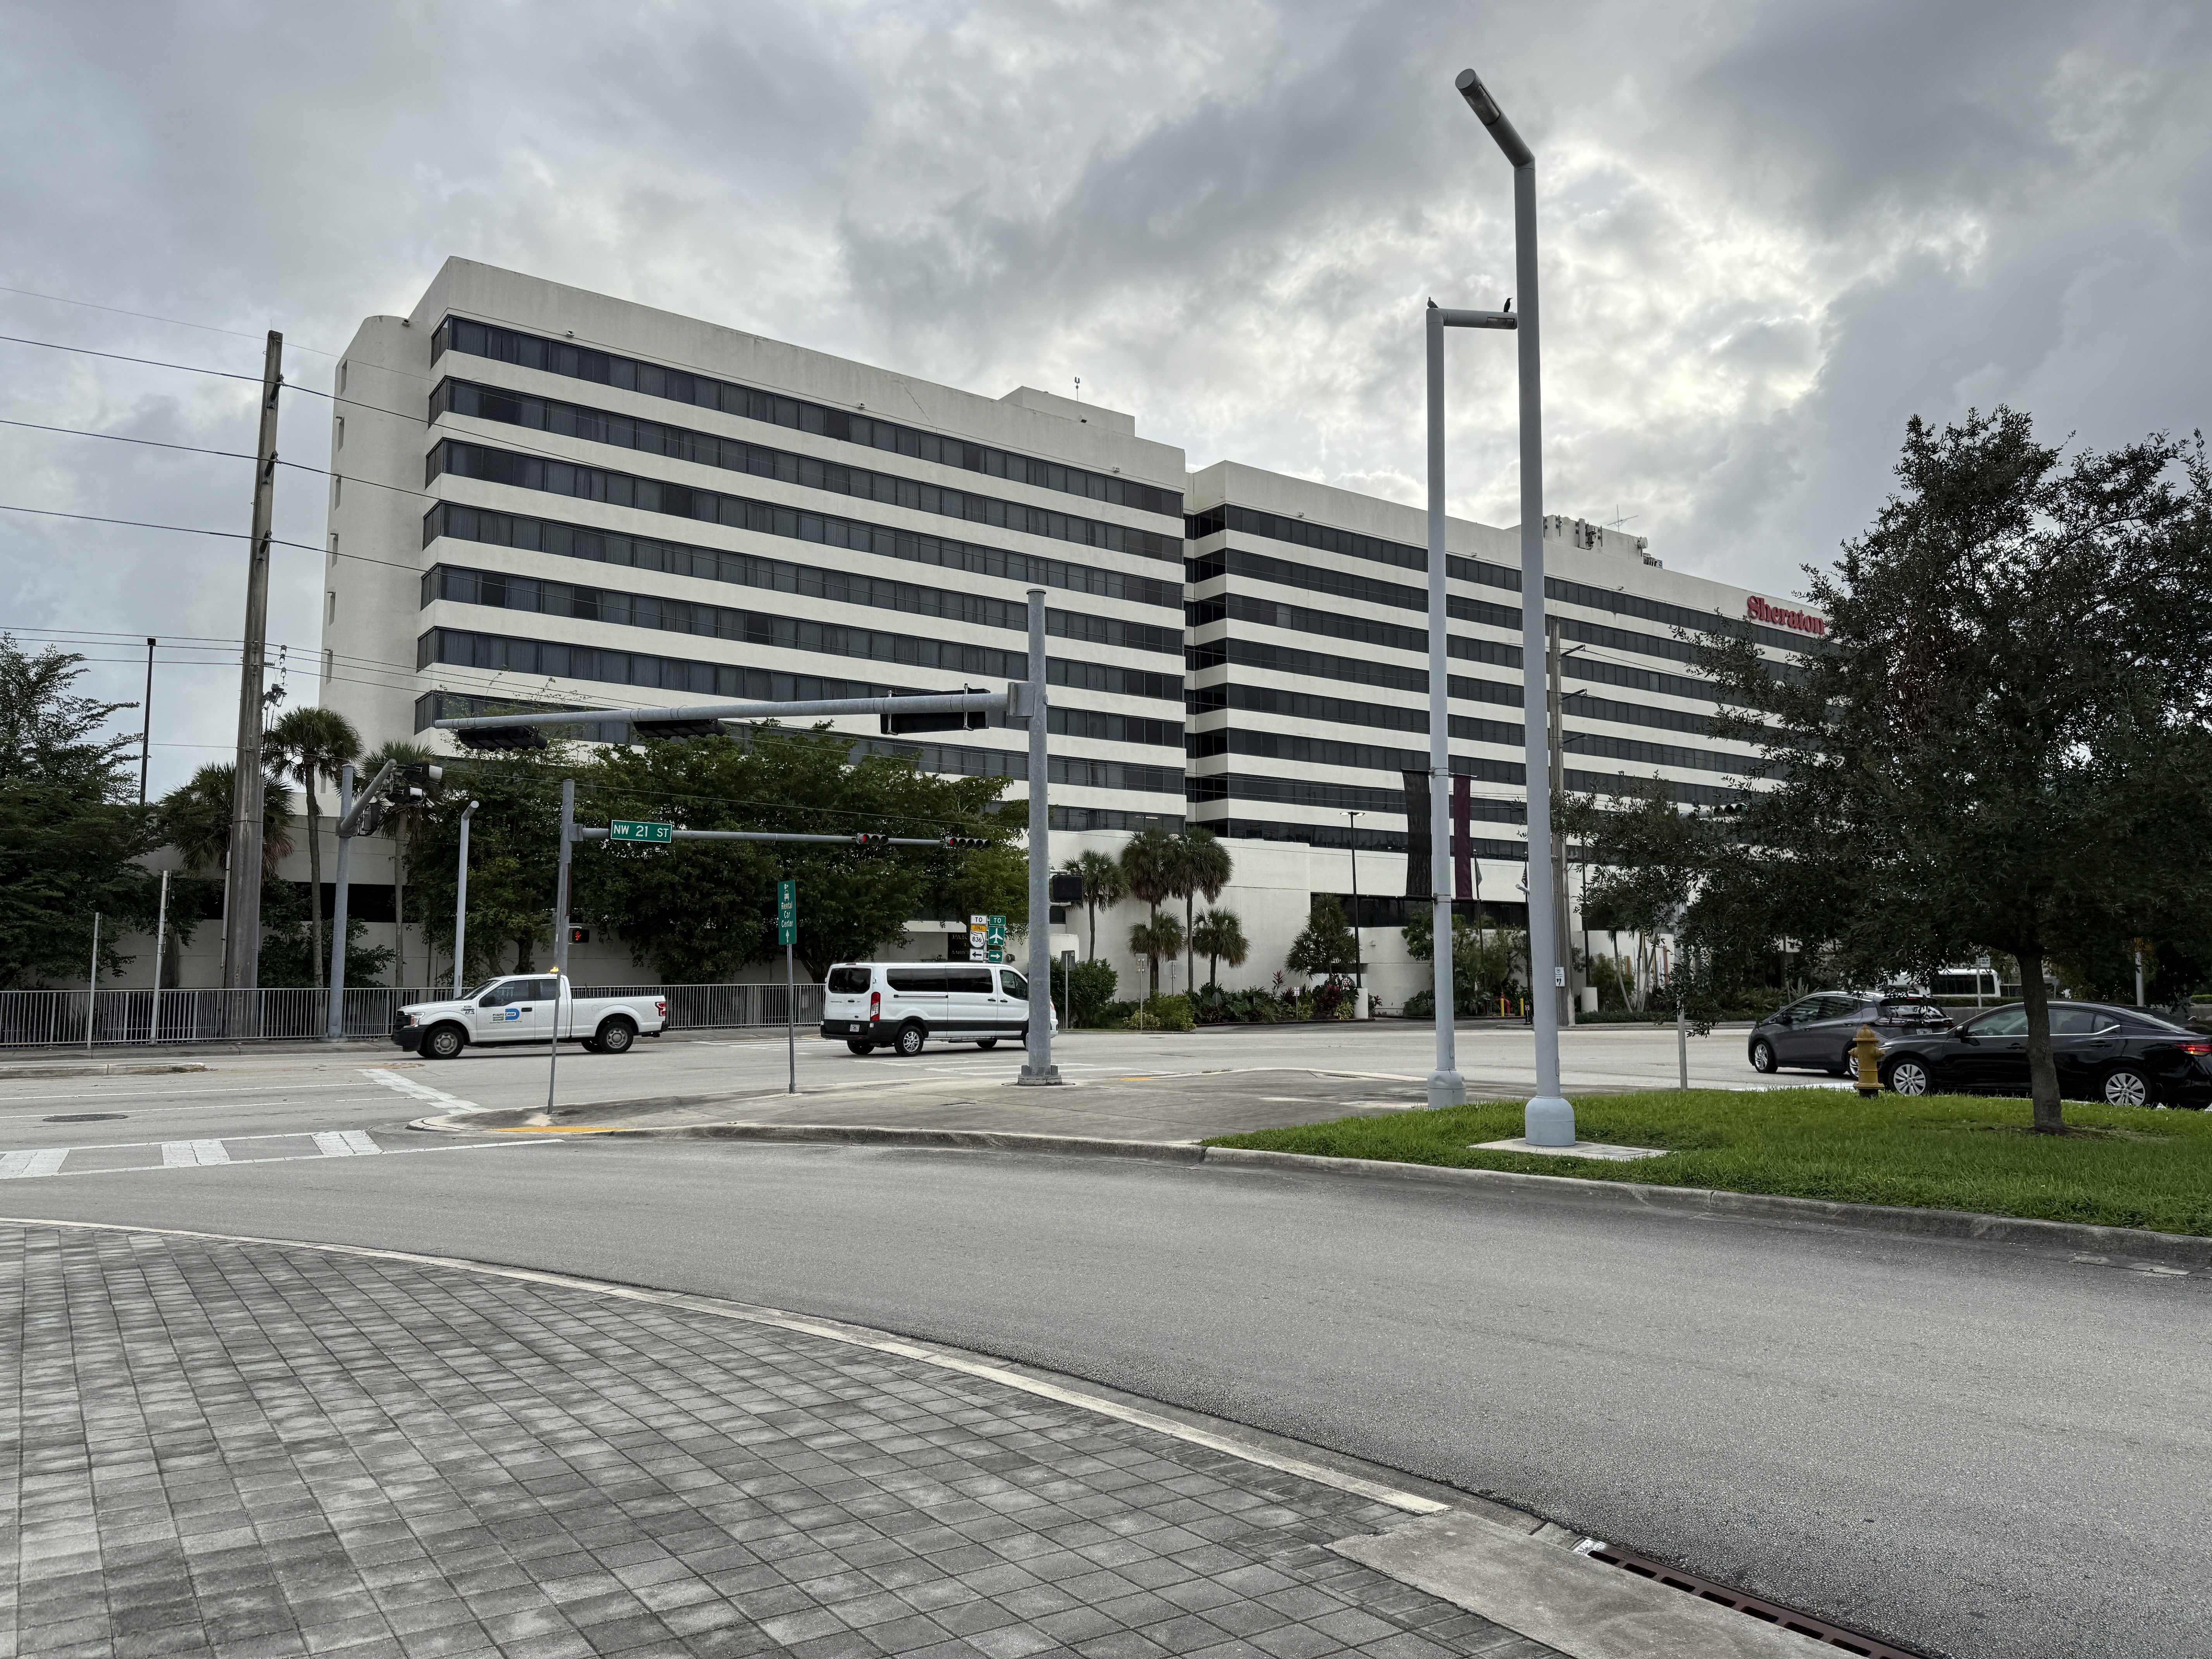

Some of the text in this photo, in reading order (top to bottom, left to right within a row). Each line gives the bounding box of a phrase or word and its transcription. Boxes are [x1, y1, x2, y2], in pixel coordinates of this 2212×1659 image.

[1747, 596, 1825, 635] Sheraton
[614, 825, 669, 838] NW 21 ST
[781, 901, 792, 910] Rental
